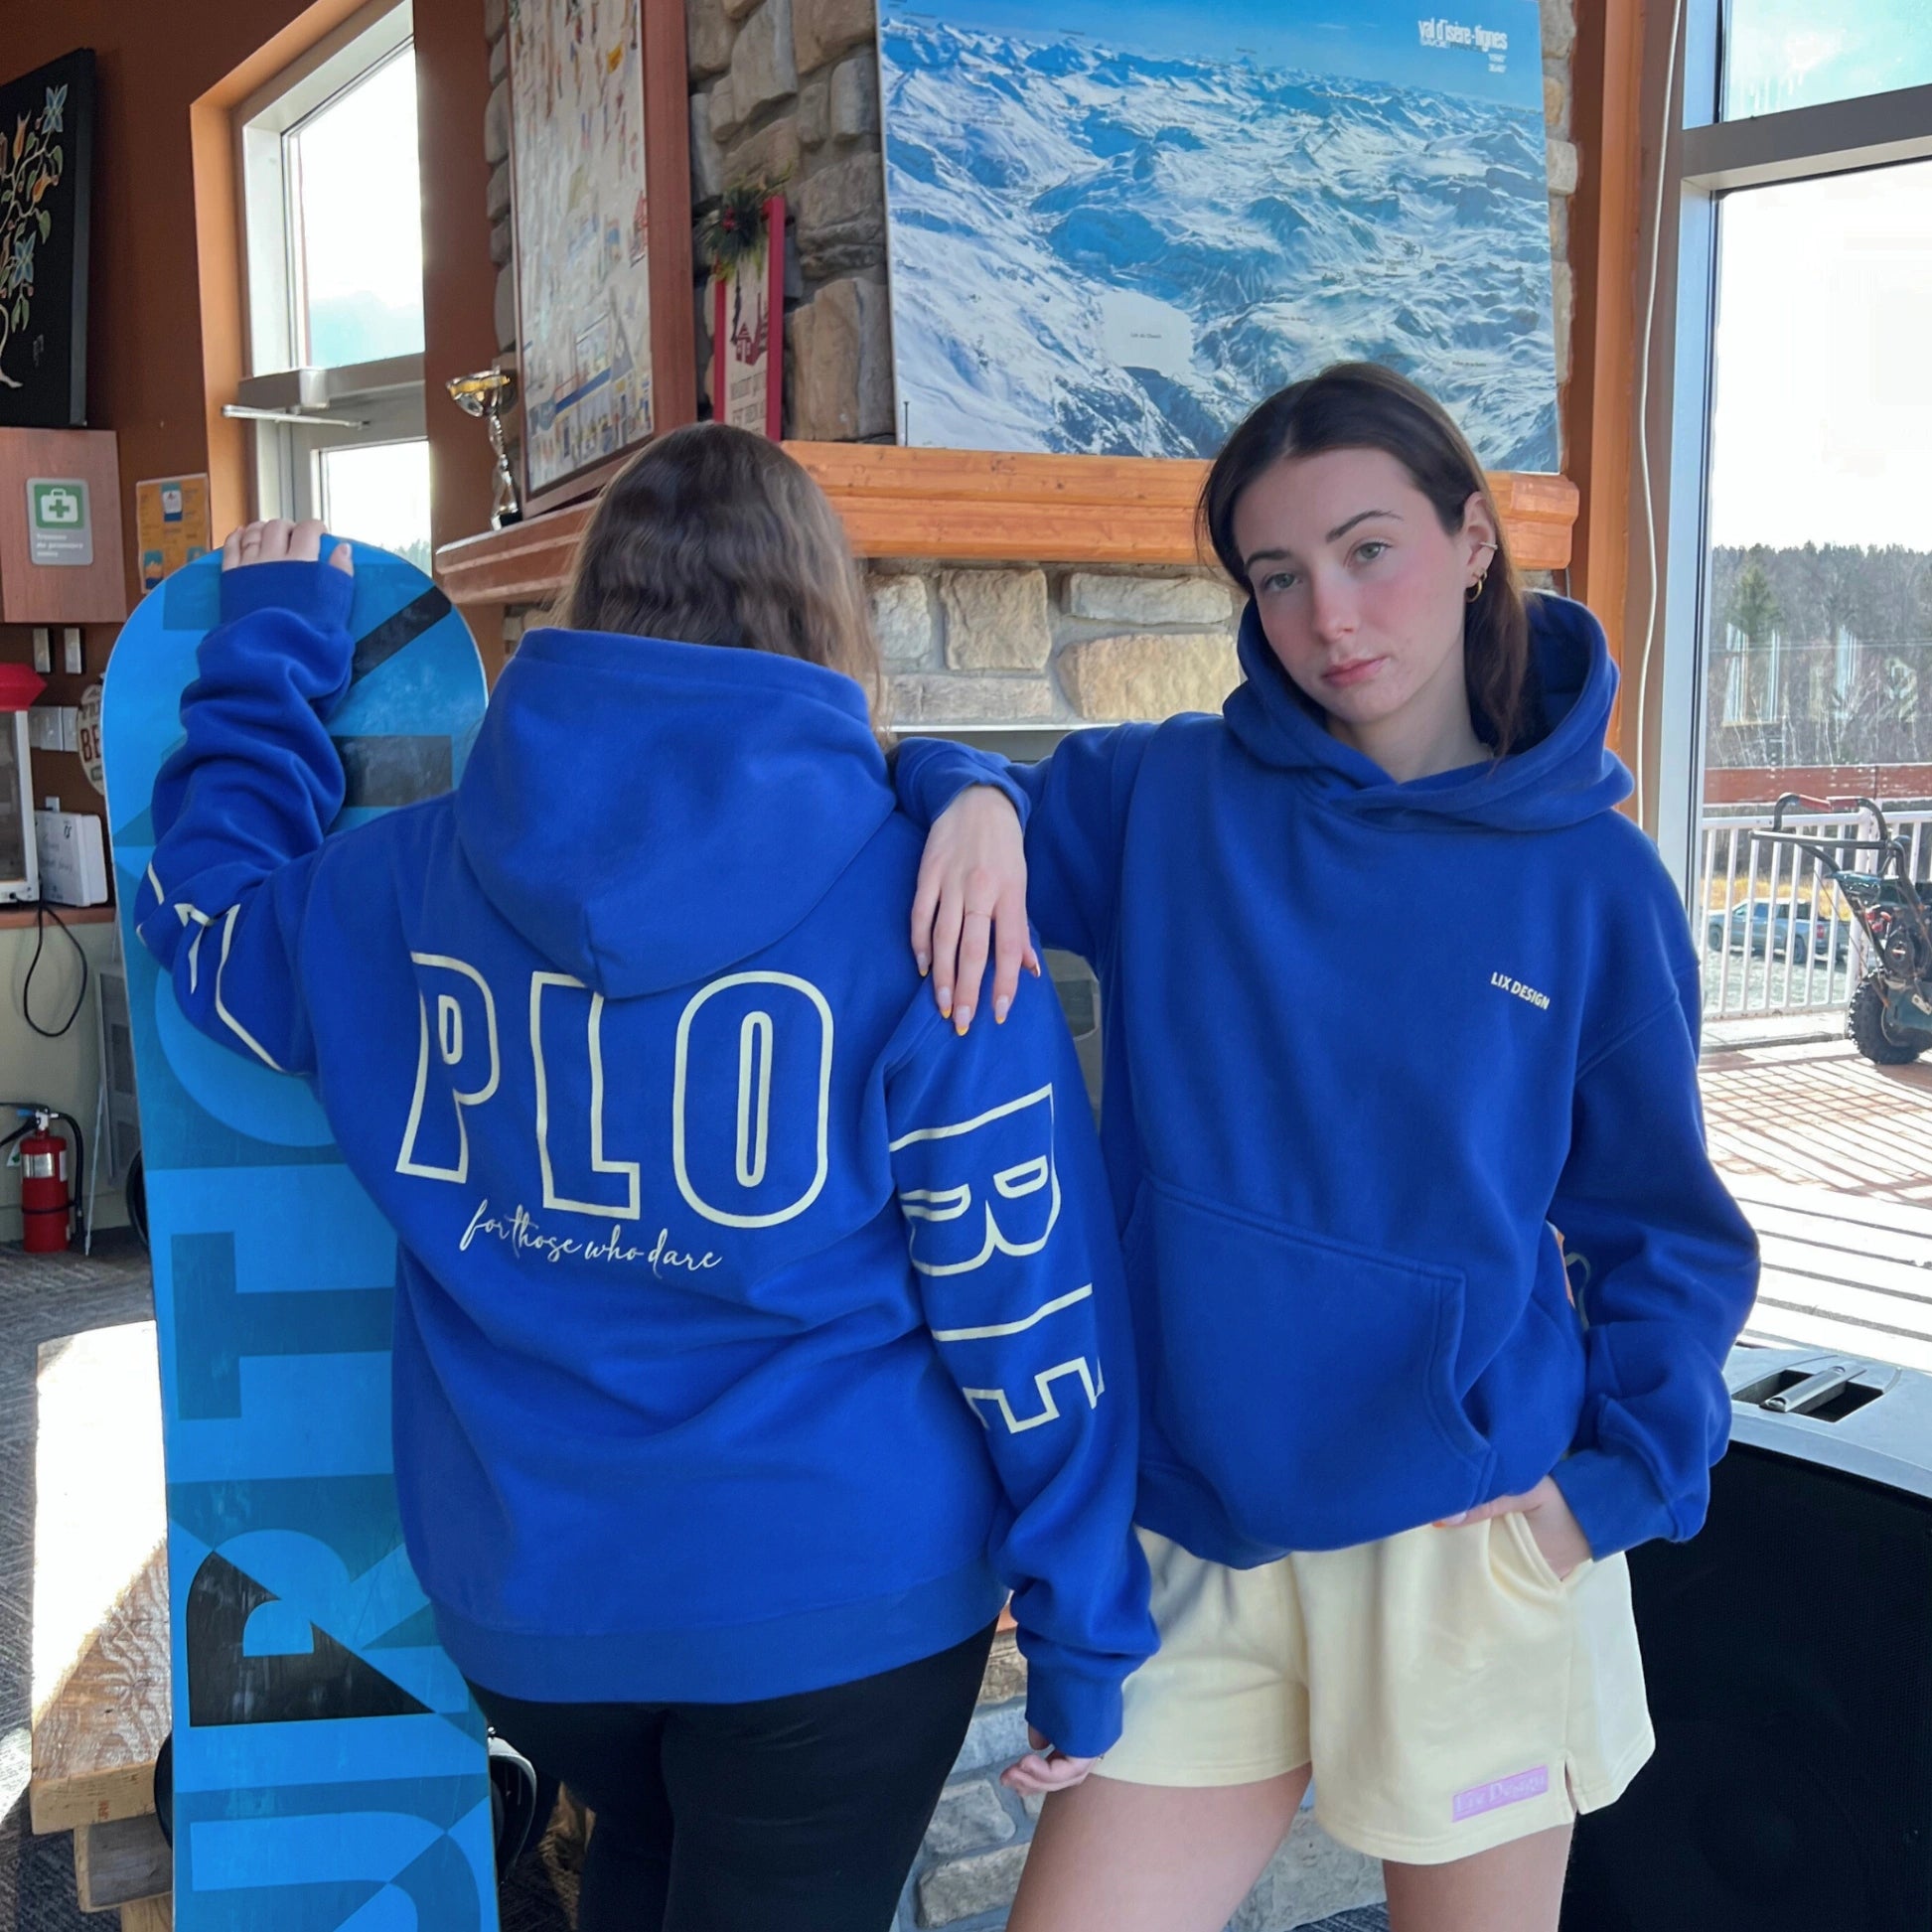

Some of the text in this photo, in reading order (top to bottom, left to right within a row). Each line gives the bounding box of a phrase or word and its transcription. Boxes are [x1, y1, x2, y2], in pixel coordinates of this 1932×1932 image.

[1490, 971, 1551, 1010] LIX DESIGN
[459, 1199, 723, 1279] for those who dare
